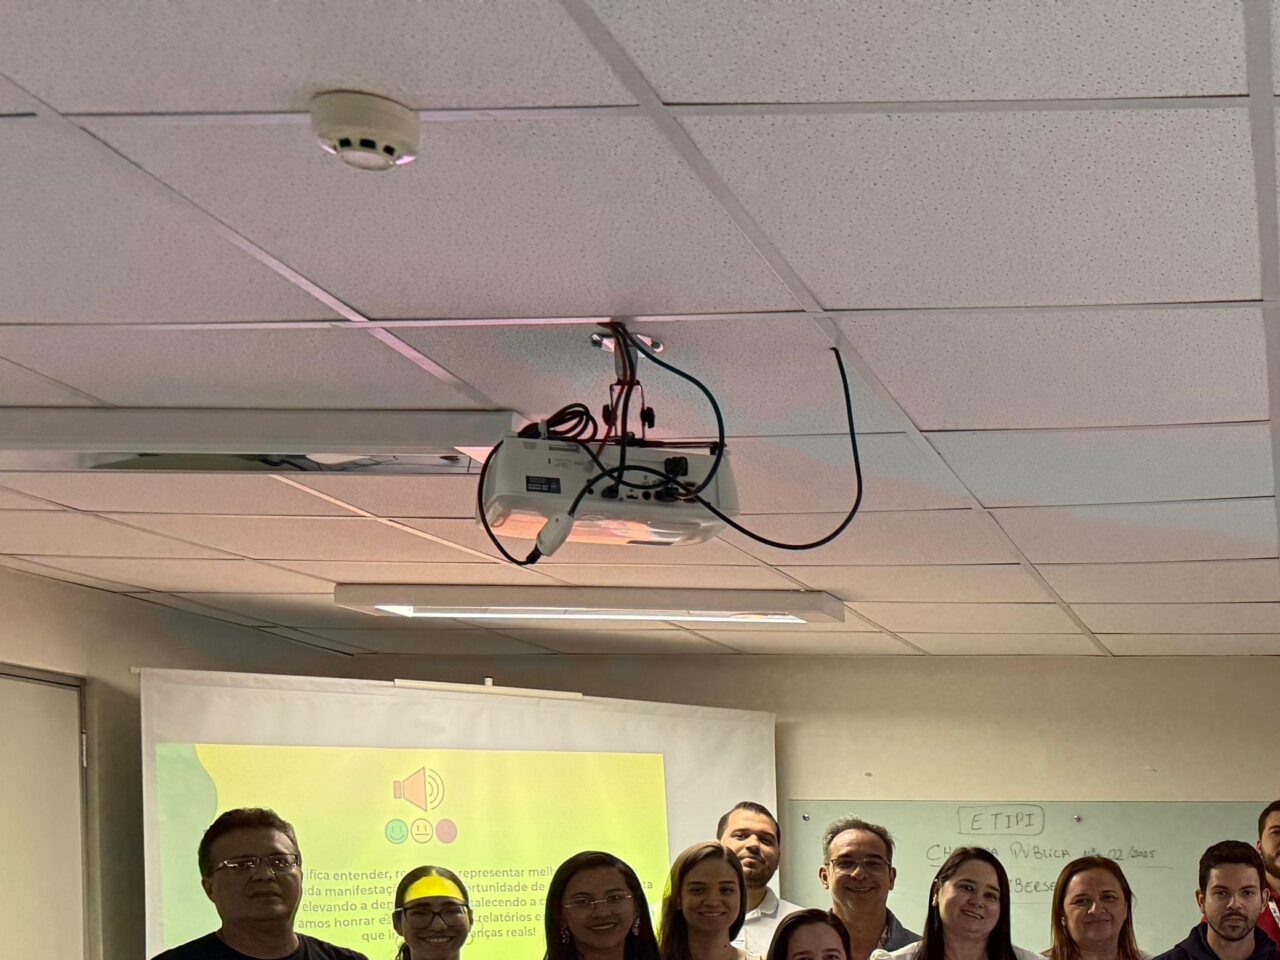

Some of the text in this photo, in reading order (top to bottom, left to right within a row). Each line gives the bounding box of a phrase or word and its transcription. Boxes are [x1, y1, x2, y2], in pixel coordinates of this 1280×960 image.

[306, 869, 330, 880] ifica
[333, 869, 392, 881] entender,
[325, 883, 397, 897] manifestaç
[468, 882, 528, 893] ortunidade
[530, 883, 545, 892] de
[302, 901, 357, 912] elevando
[471, 897, 527, 908] talecendo
[298, 920, 331, 929] amos
[334, 917, 375, 928] honrar
[478, 912, 532, 923] relatórios
[535, 913, 541, 921] e
[361, 931, 386, 943] que
[470, 929, 503, 940] anças
[506, 926, 537, 937] reais!
